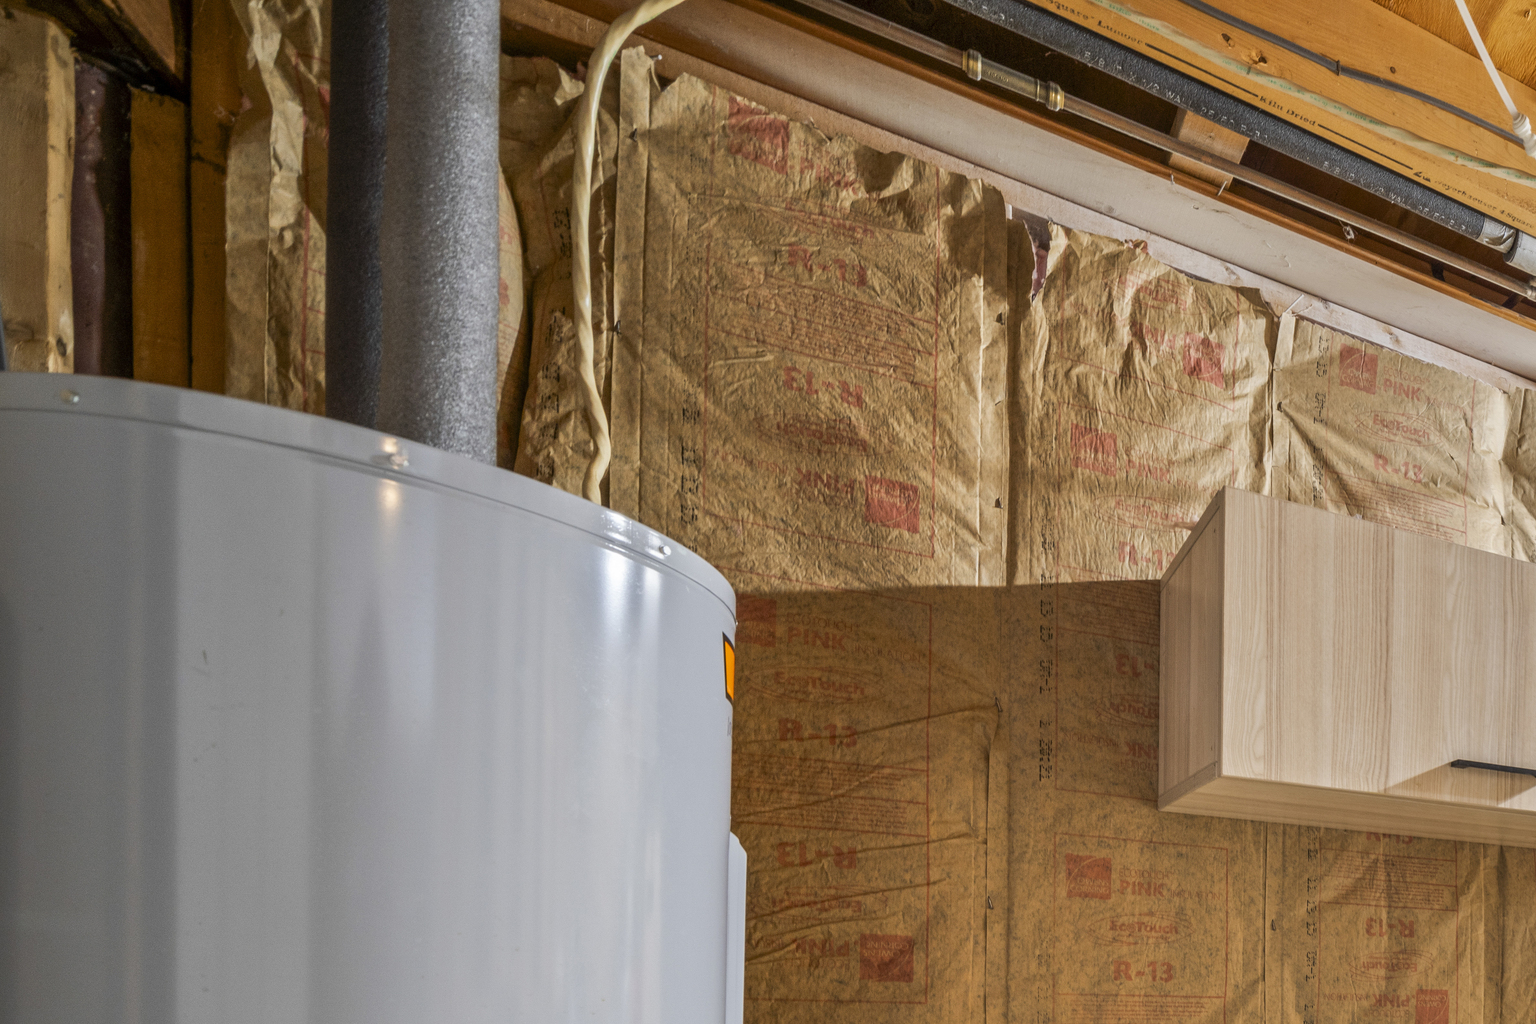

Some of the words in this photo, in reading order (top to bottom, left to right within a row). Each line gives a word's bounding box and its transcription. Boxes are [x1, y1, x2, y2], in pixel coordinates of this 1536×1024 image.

[1258, 95, 1284, 112] Kiln
[1286, 108, 1317, 127] Dried
[782, 366, 864, 409] R-13
[1383, 379, 1422, 401] PINK
[1372, 414, 1429, 441] EcoTouch
[1373, 454, 1422, 483] R-13
[787, 626, 848, 650] PINK
[774, 671, 865, 695] EcoTouch
[778, 717, 858, 747] R-13
[776, 842, 857, 869] R-13
[1070, 885, 1110, 894] CORNING
[1120, 881, 1167, 898] PINK
[1171, 889, 1222, 900] INSULATION
[1108, 920, 1179, 935] EcoTouch
[1365, 917, 1415, 938] R-13
[1113, 960, 1174, 983] R-13
[1361, 960, 1418, 973] EcoTouch
[1372, 993, 1410, 1009] PINK
